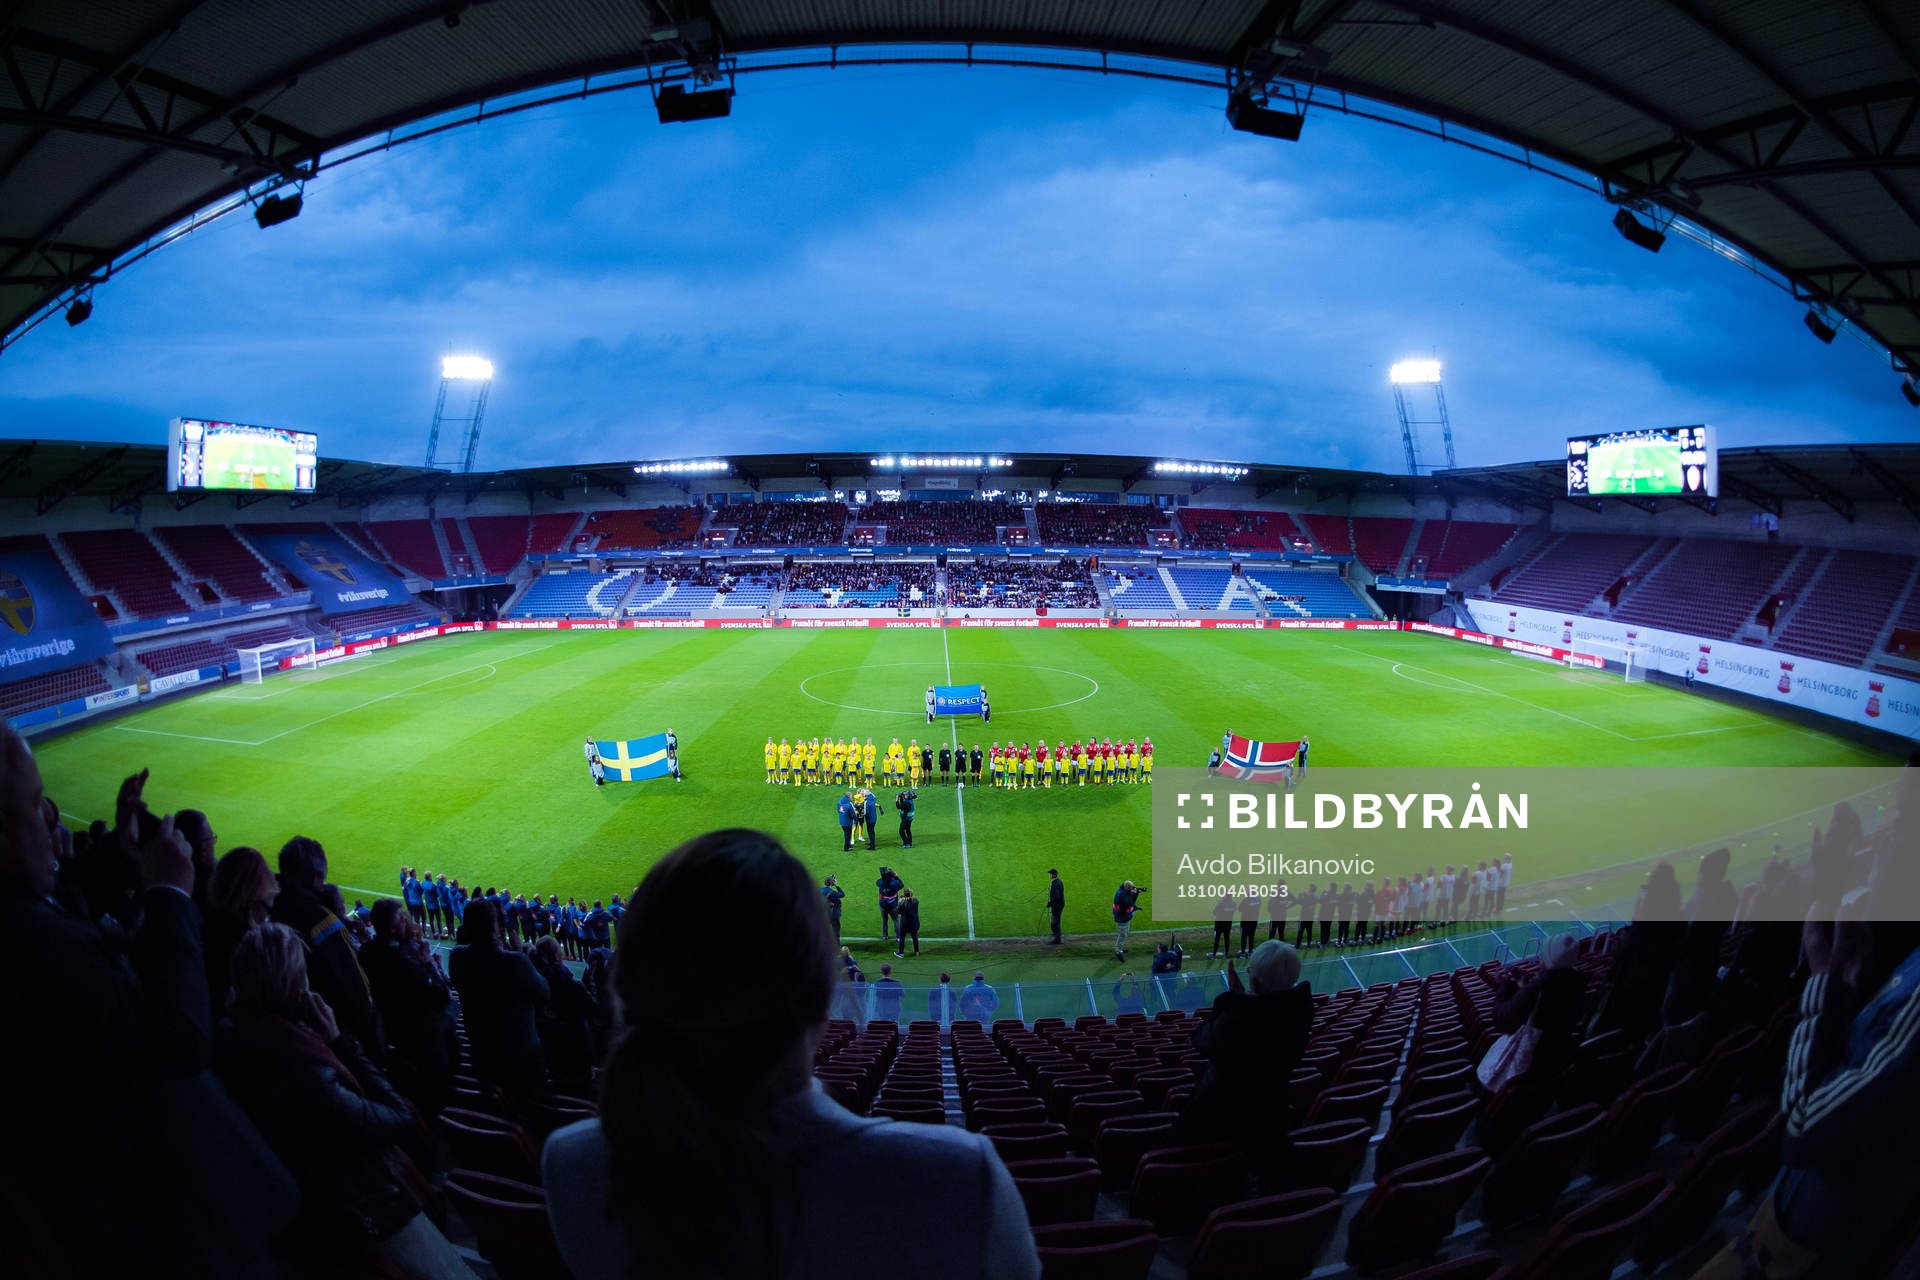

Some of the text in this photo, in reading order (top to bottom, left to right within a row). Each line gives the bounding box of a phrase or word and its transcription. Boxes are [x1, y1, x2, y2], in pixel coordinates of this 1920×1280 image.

[1715, 658, 1770, 680] HELSINGBORG
[1797, 677, 1859, 701] HELSINGBORG
[948, 697, 981, 705] RESPECT
